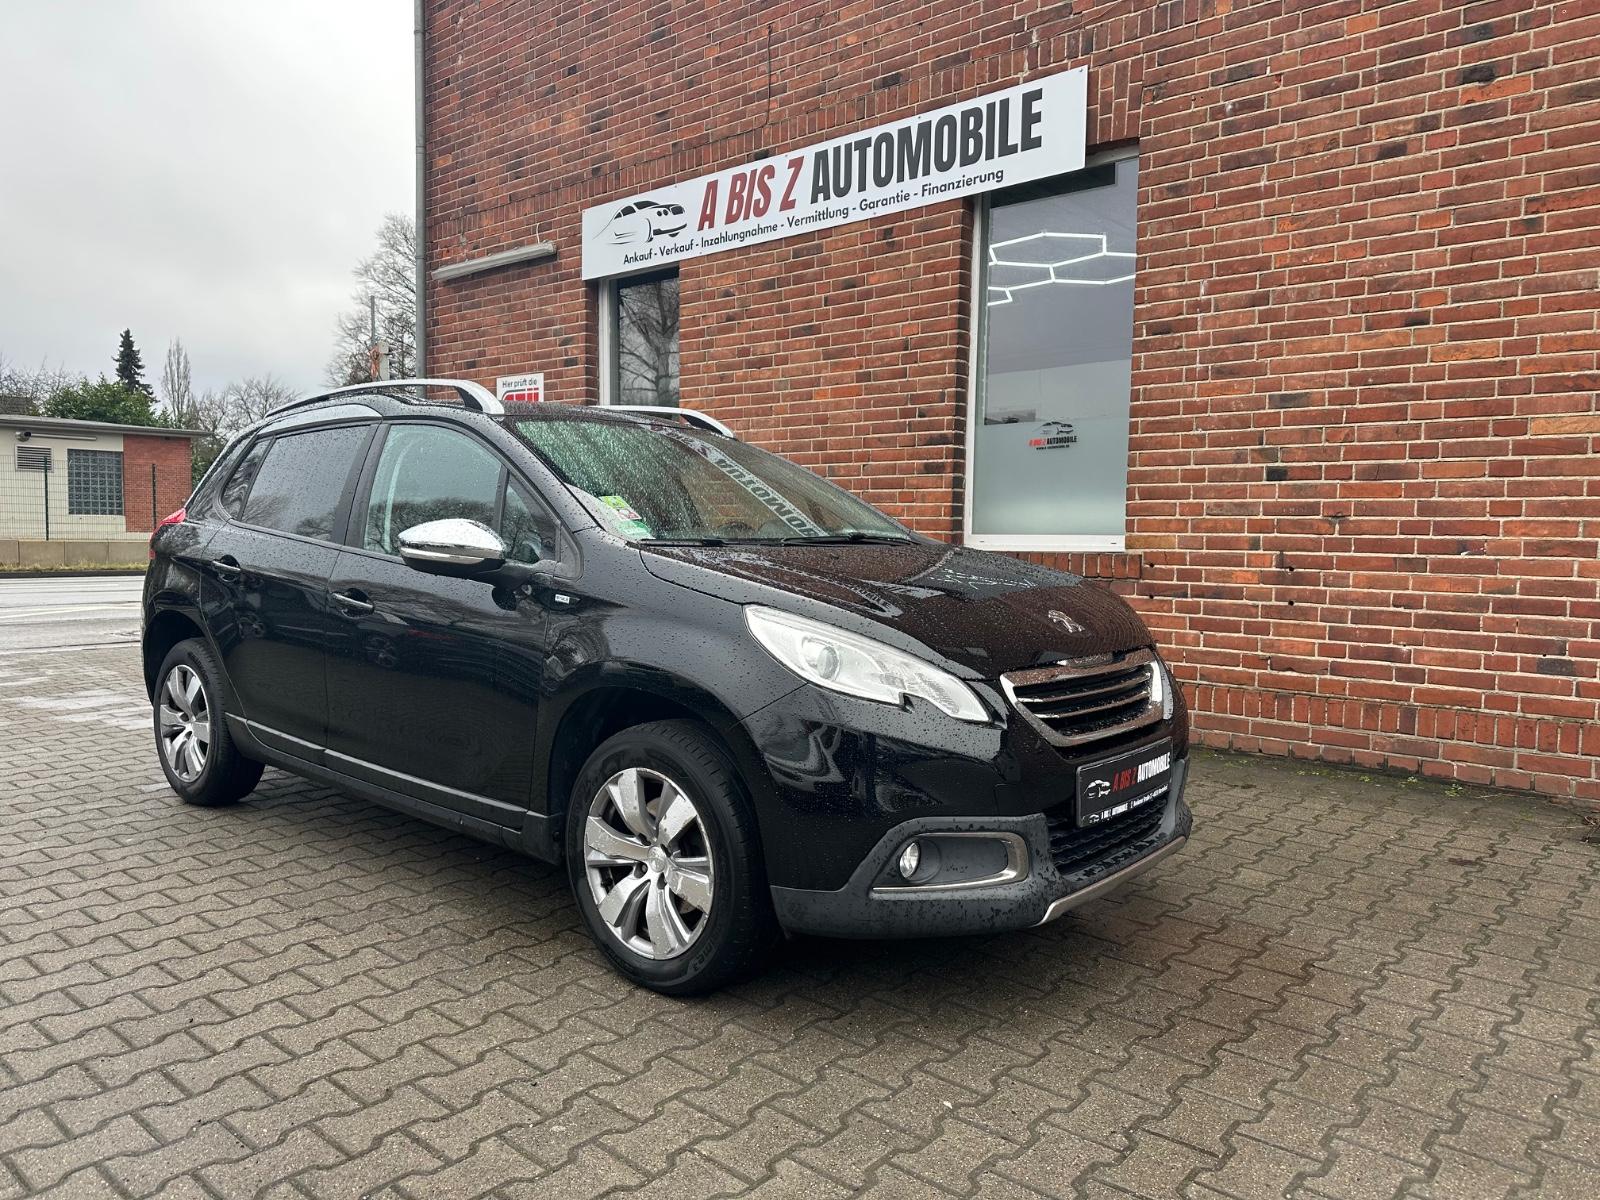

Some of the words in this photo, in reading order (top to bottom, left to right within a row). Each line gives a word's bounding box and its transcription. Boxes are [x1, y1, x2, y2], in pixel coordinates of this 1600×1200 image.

[697, 179, 718, 232] A
[725, 165, 775, 226] BIS
[779, 156, 805, 212] Z
[810, 88, 1043, 205] AUTOMOBILE
[623, 248, 652, 264] Ankauf
[659, 239, 694, 256] Verkauf
[701, 224, 778, 248] Inzahlungnahme
[787, 206, 849, 228] Vermittlung
[859, 189, 910, 212] Garantie
[921, 169, 1004, 197] Finanzierung
[528, 377, 537, 386] die
[1047, 436, 1077, 444] AUTOMOBILE
[1113, 771, 1120, 792] A
[1120, 768, 1132, 790] BIS
[1131, 767, 1138, 785] Z
[1137, 752, 1171, 783] AUTOMOBILE
